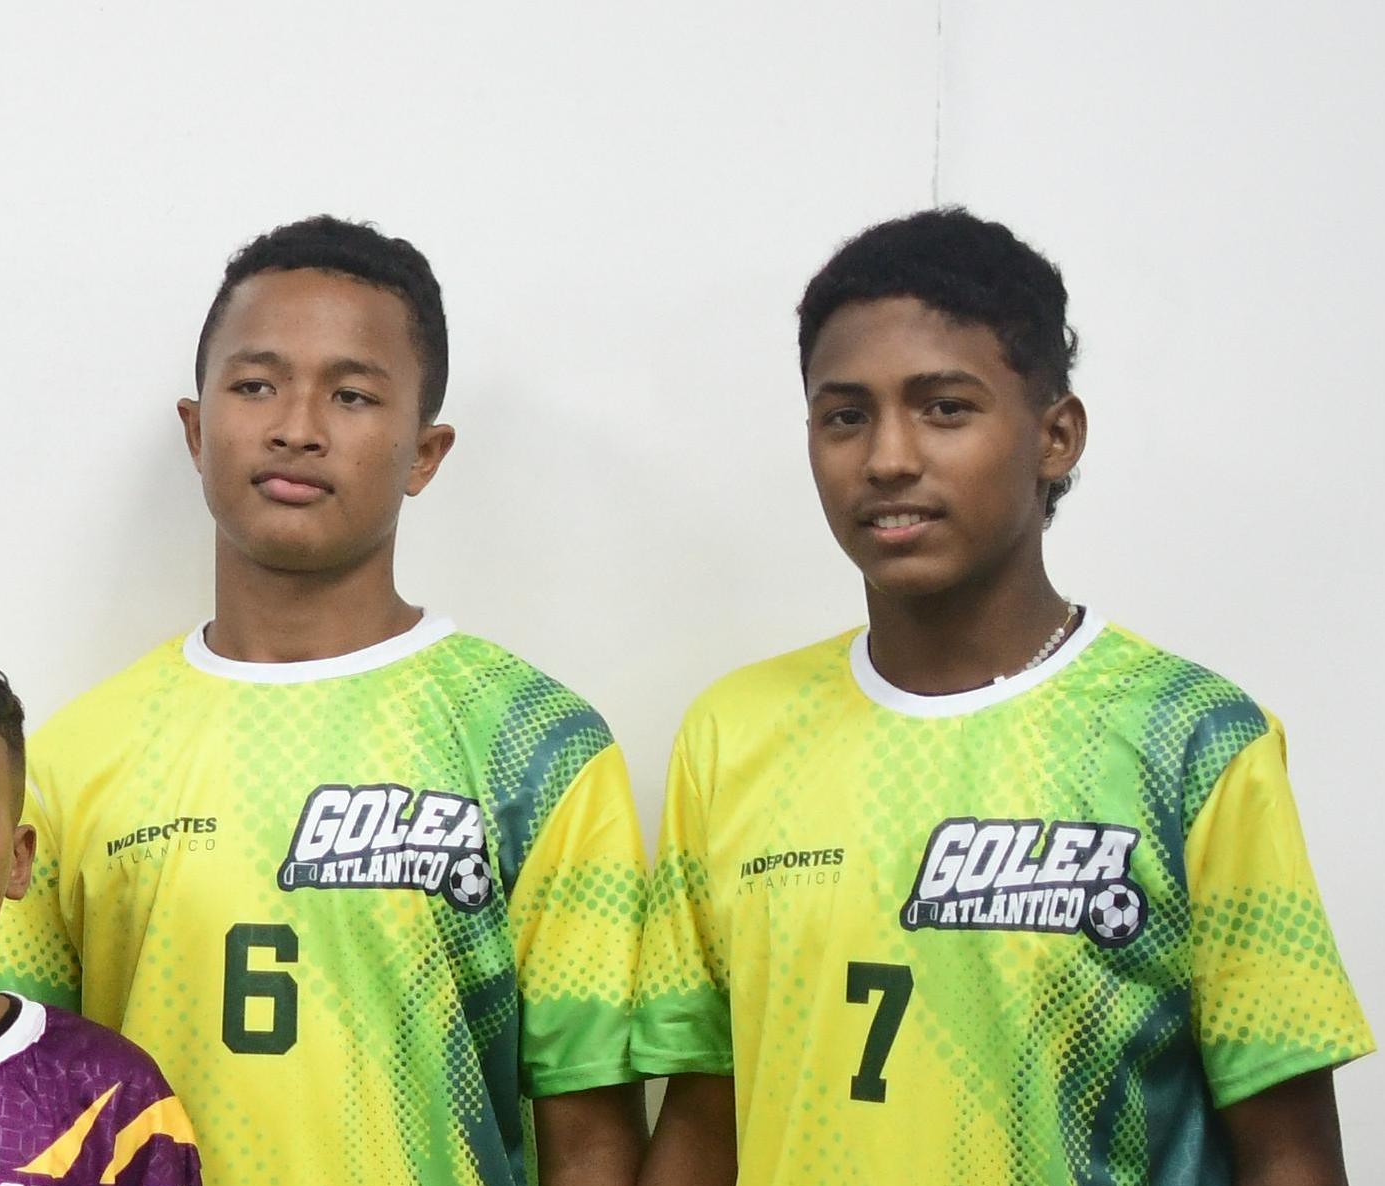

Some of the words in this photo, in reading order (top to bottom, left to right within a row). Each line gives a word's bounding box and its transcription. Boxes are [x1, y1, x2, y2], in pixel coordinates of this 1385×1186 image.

[295, 788, 485, 861] GOLEA
[919, 823, 1136, 900] GOLEA
[940, 888, 1086, 928] ATLÁNTICO
[222, 923, 298, 1055] 6
[846, 961, 914, 1103] 7
